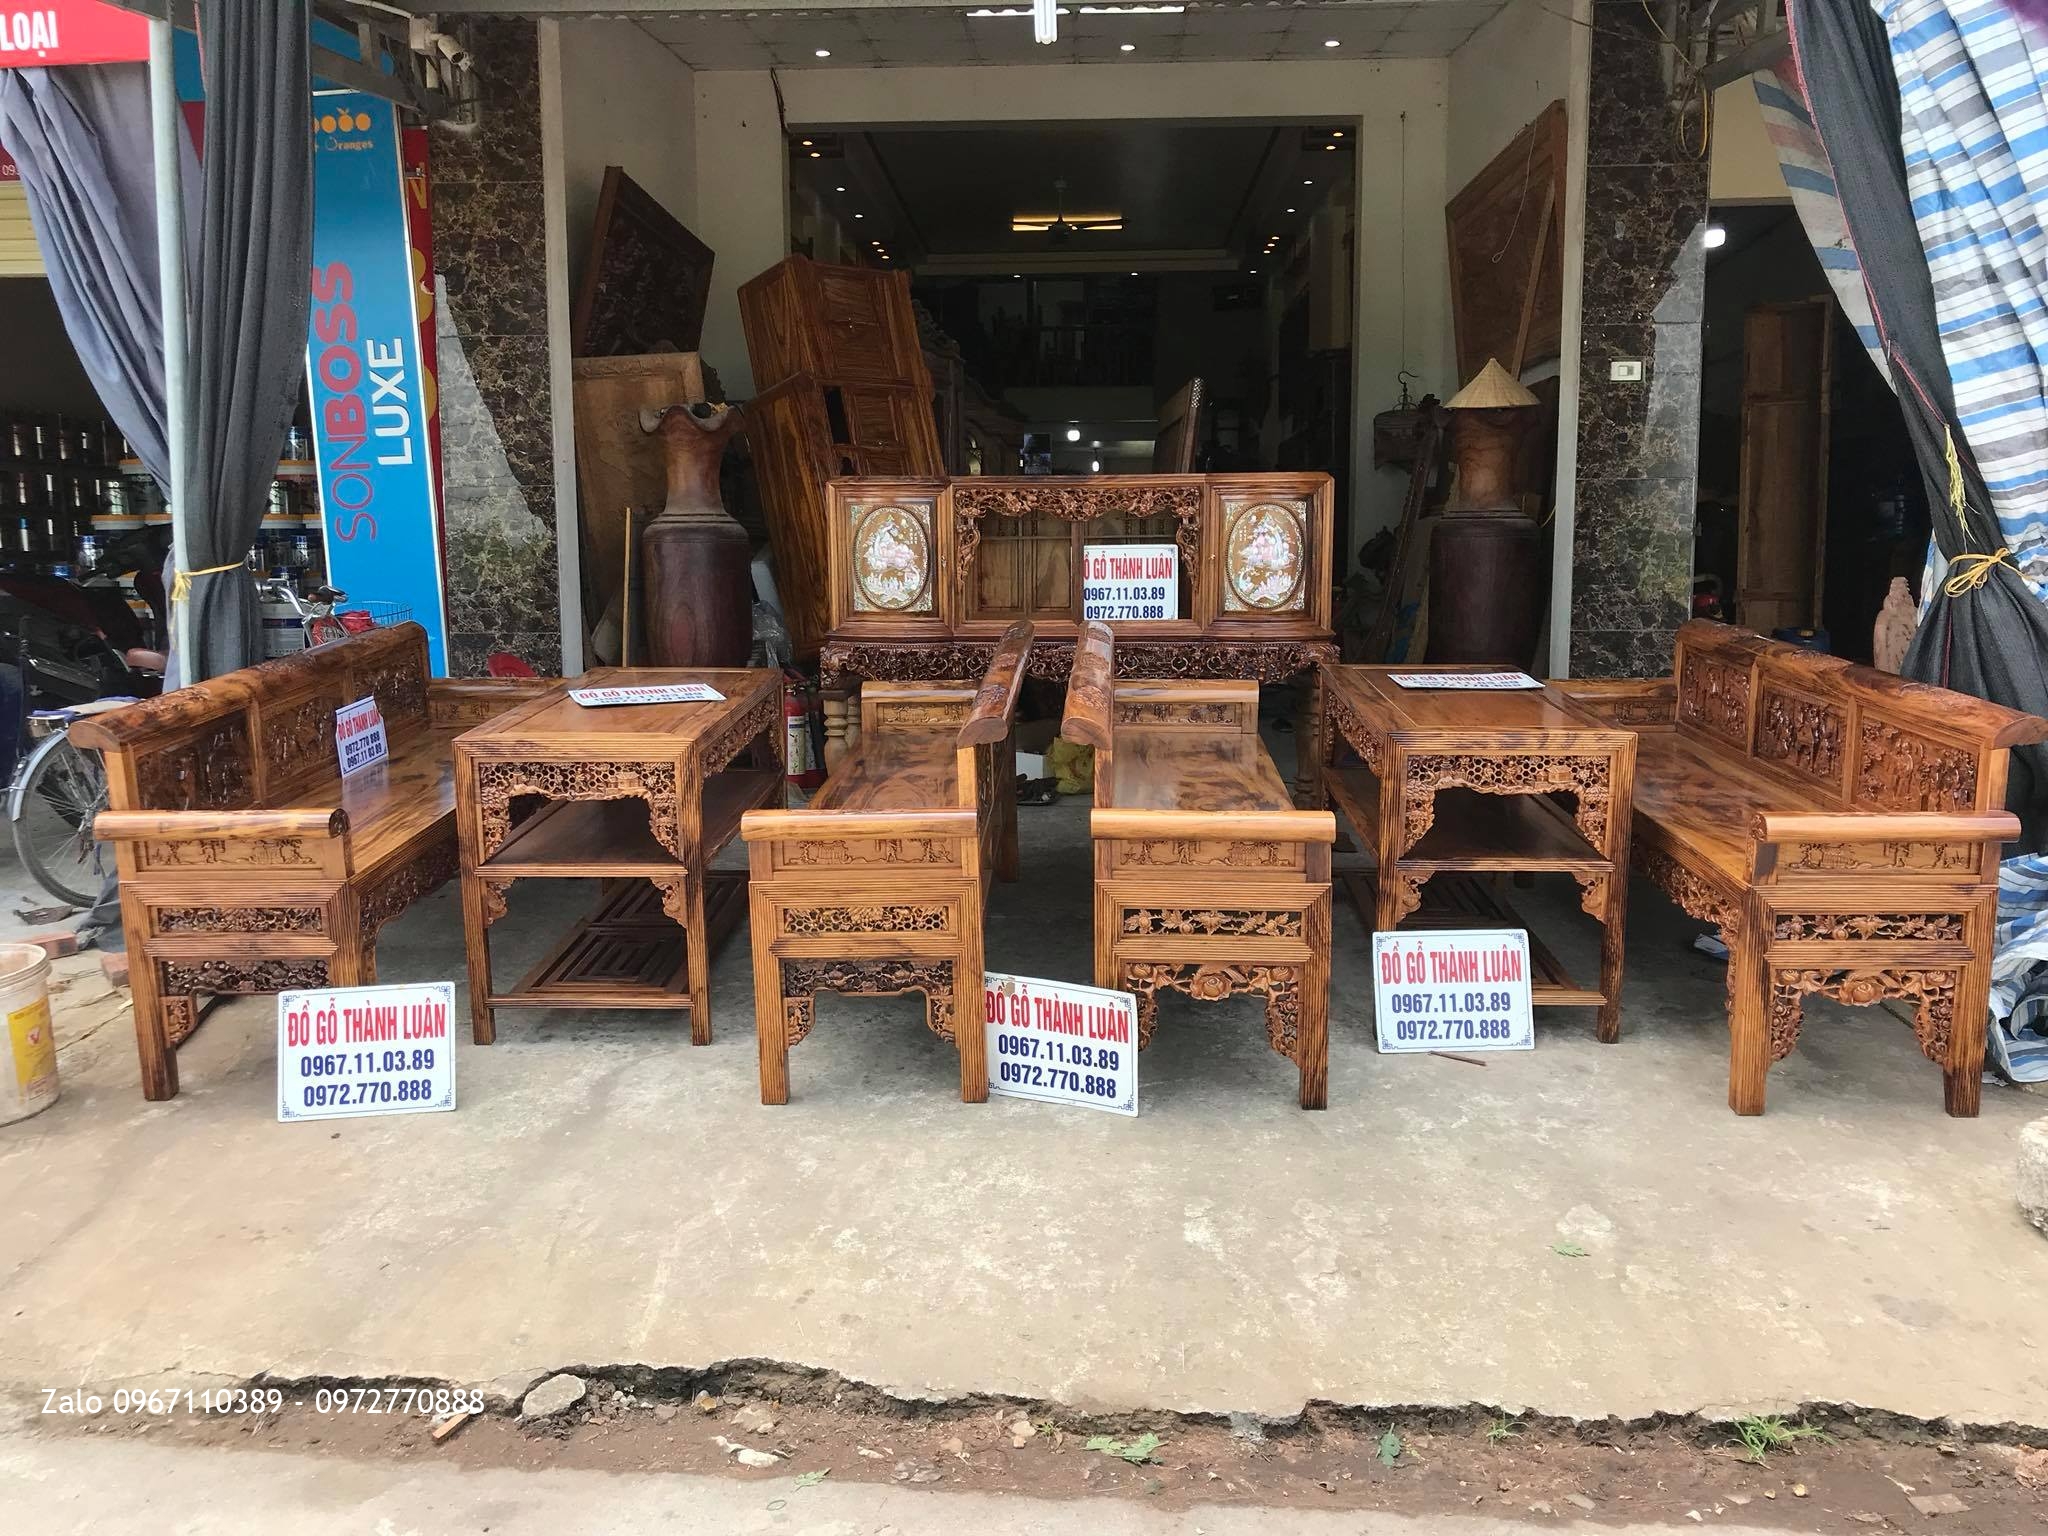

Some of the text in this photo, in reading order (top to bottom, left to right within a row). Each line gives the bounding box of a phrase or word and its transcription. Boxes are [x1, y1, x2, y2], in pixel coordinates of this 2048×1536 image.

[0, 10, 59, 58] LOẠI
[2, 164, 21, 176] 09
[312, 261, 378, 542] SONBOSS
[366, 337, 414, 465] LUXE
[1083, 551, 1172, 580] Ồ GỖ THÀNH LUÂN
[1084, 587, 1165, 601] 0967.11.03.89
[1086, 605, 1164, 619] 0972.770.888
[1381, 941, 1522, 985] ĐỒ GỖ THÀNH LUÂN
[985, 982, 1129, 1044] ĐỒ GỖ THÀNH LUÂN
[1391, 992, 1511, 1014] 0967.11.03.89
[288, 997, 446, 1047] ĐỒ GỖ THÀNH LUÂN
[1397, 1019, 1511, 1041] 0972.770.888
[300, 1048, 435, 1077] 0967.11.03.89
[998, 1034, 1119, 1071] 0967.11.03.89
[303, 1079, 432, 1107] 0972.770.888
[1000, 1061, 1117, 1099] 0972.770.888
